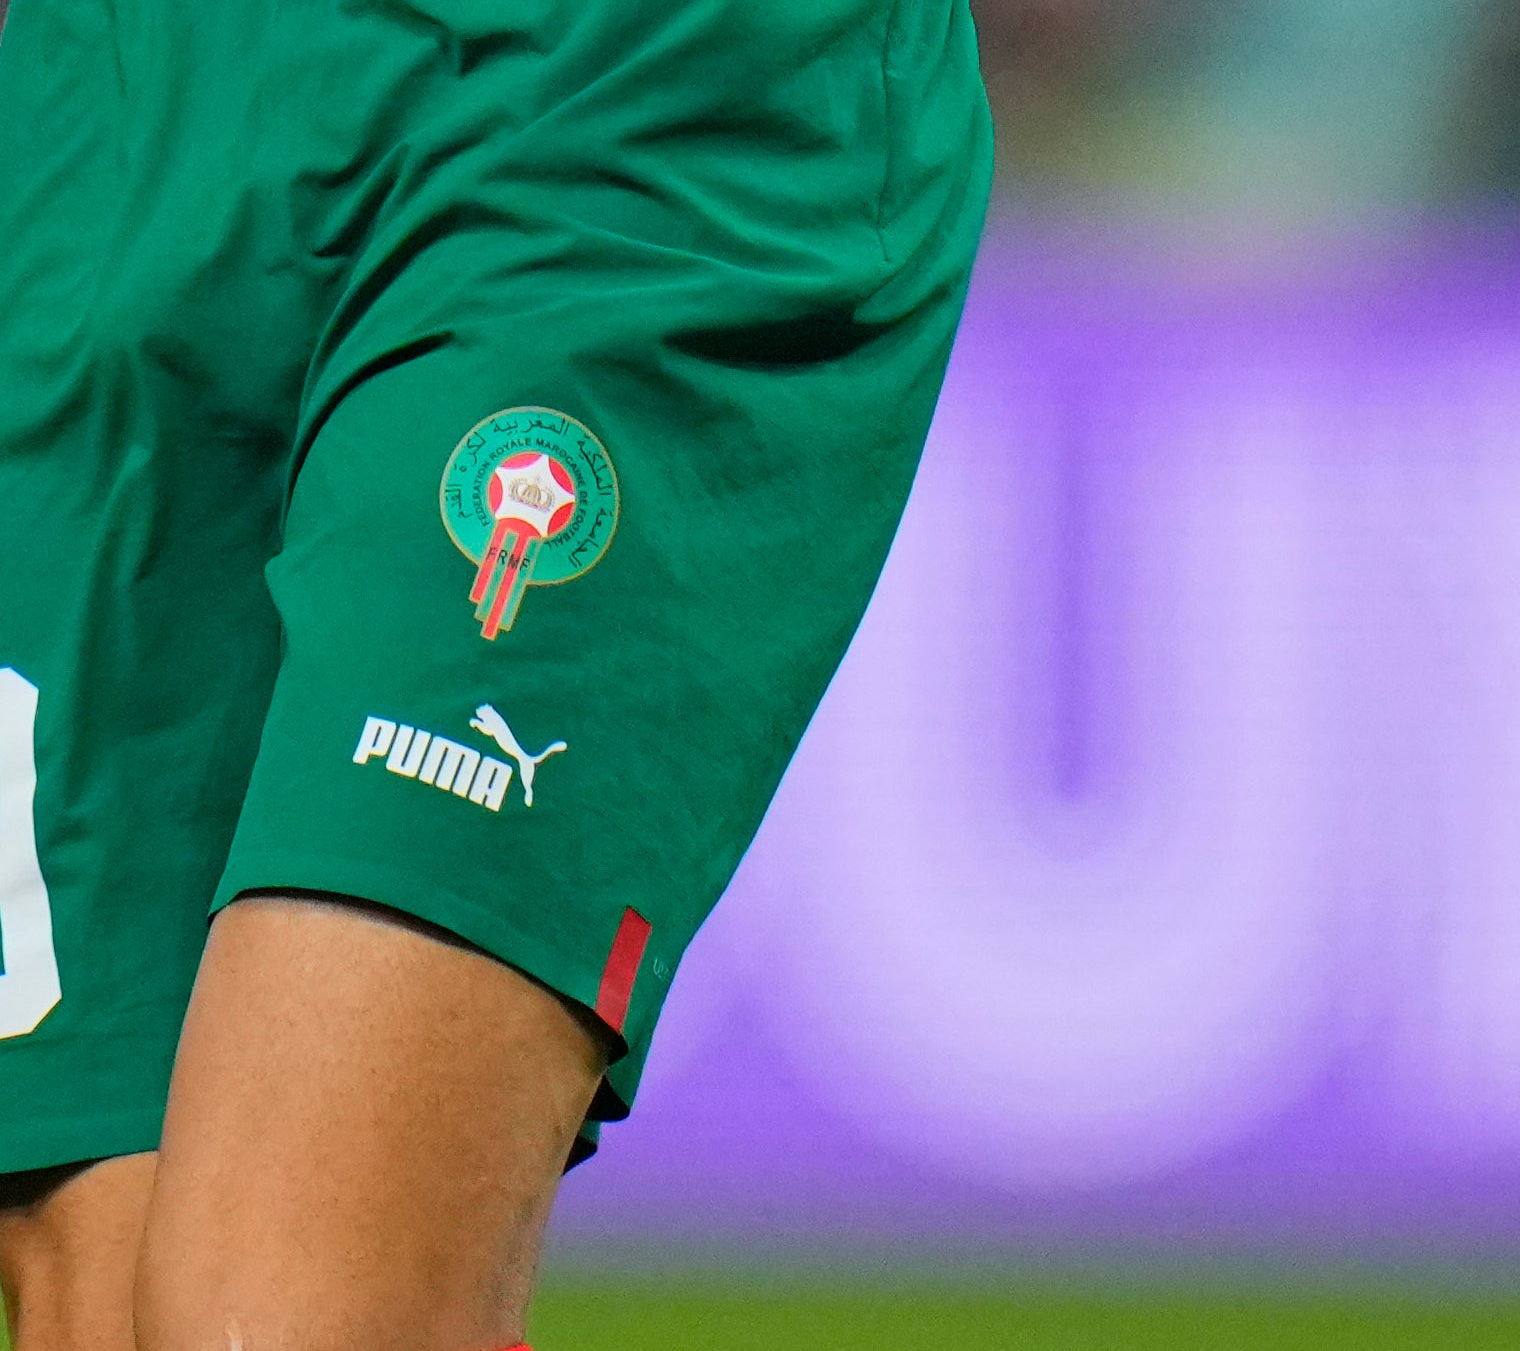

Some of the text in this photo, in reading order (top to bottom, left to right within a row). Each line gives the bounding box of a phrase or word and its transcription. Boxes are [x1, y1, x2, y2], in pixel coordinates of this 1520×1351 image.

[493, 414, 570, 436] المغربية
[489, 438, 531, 459] ROYALE
[535, 438, 586, 487] MAROCAINE
[579, 491, 588, 507] DE
[544, 508, 586, 549] FOOTBALL
[486, 547, 531, 571] FRMF
[352, 716, 513, 812] PUMA
